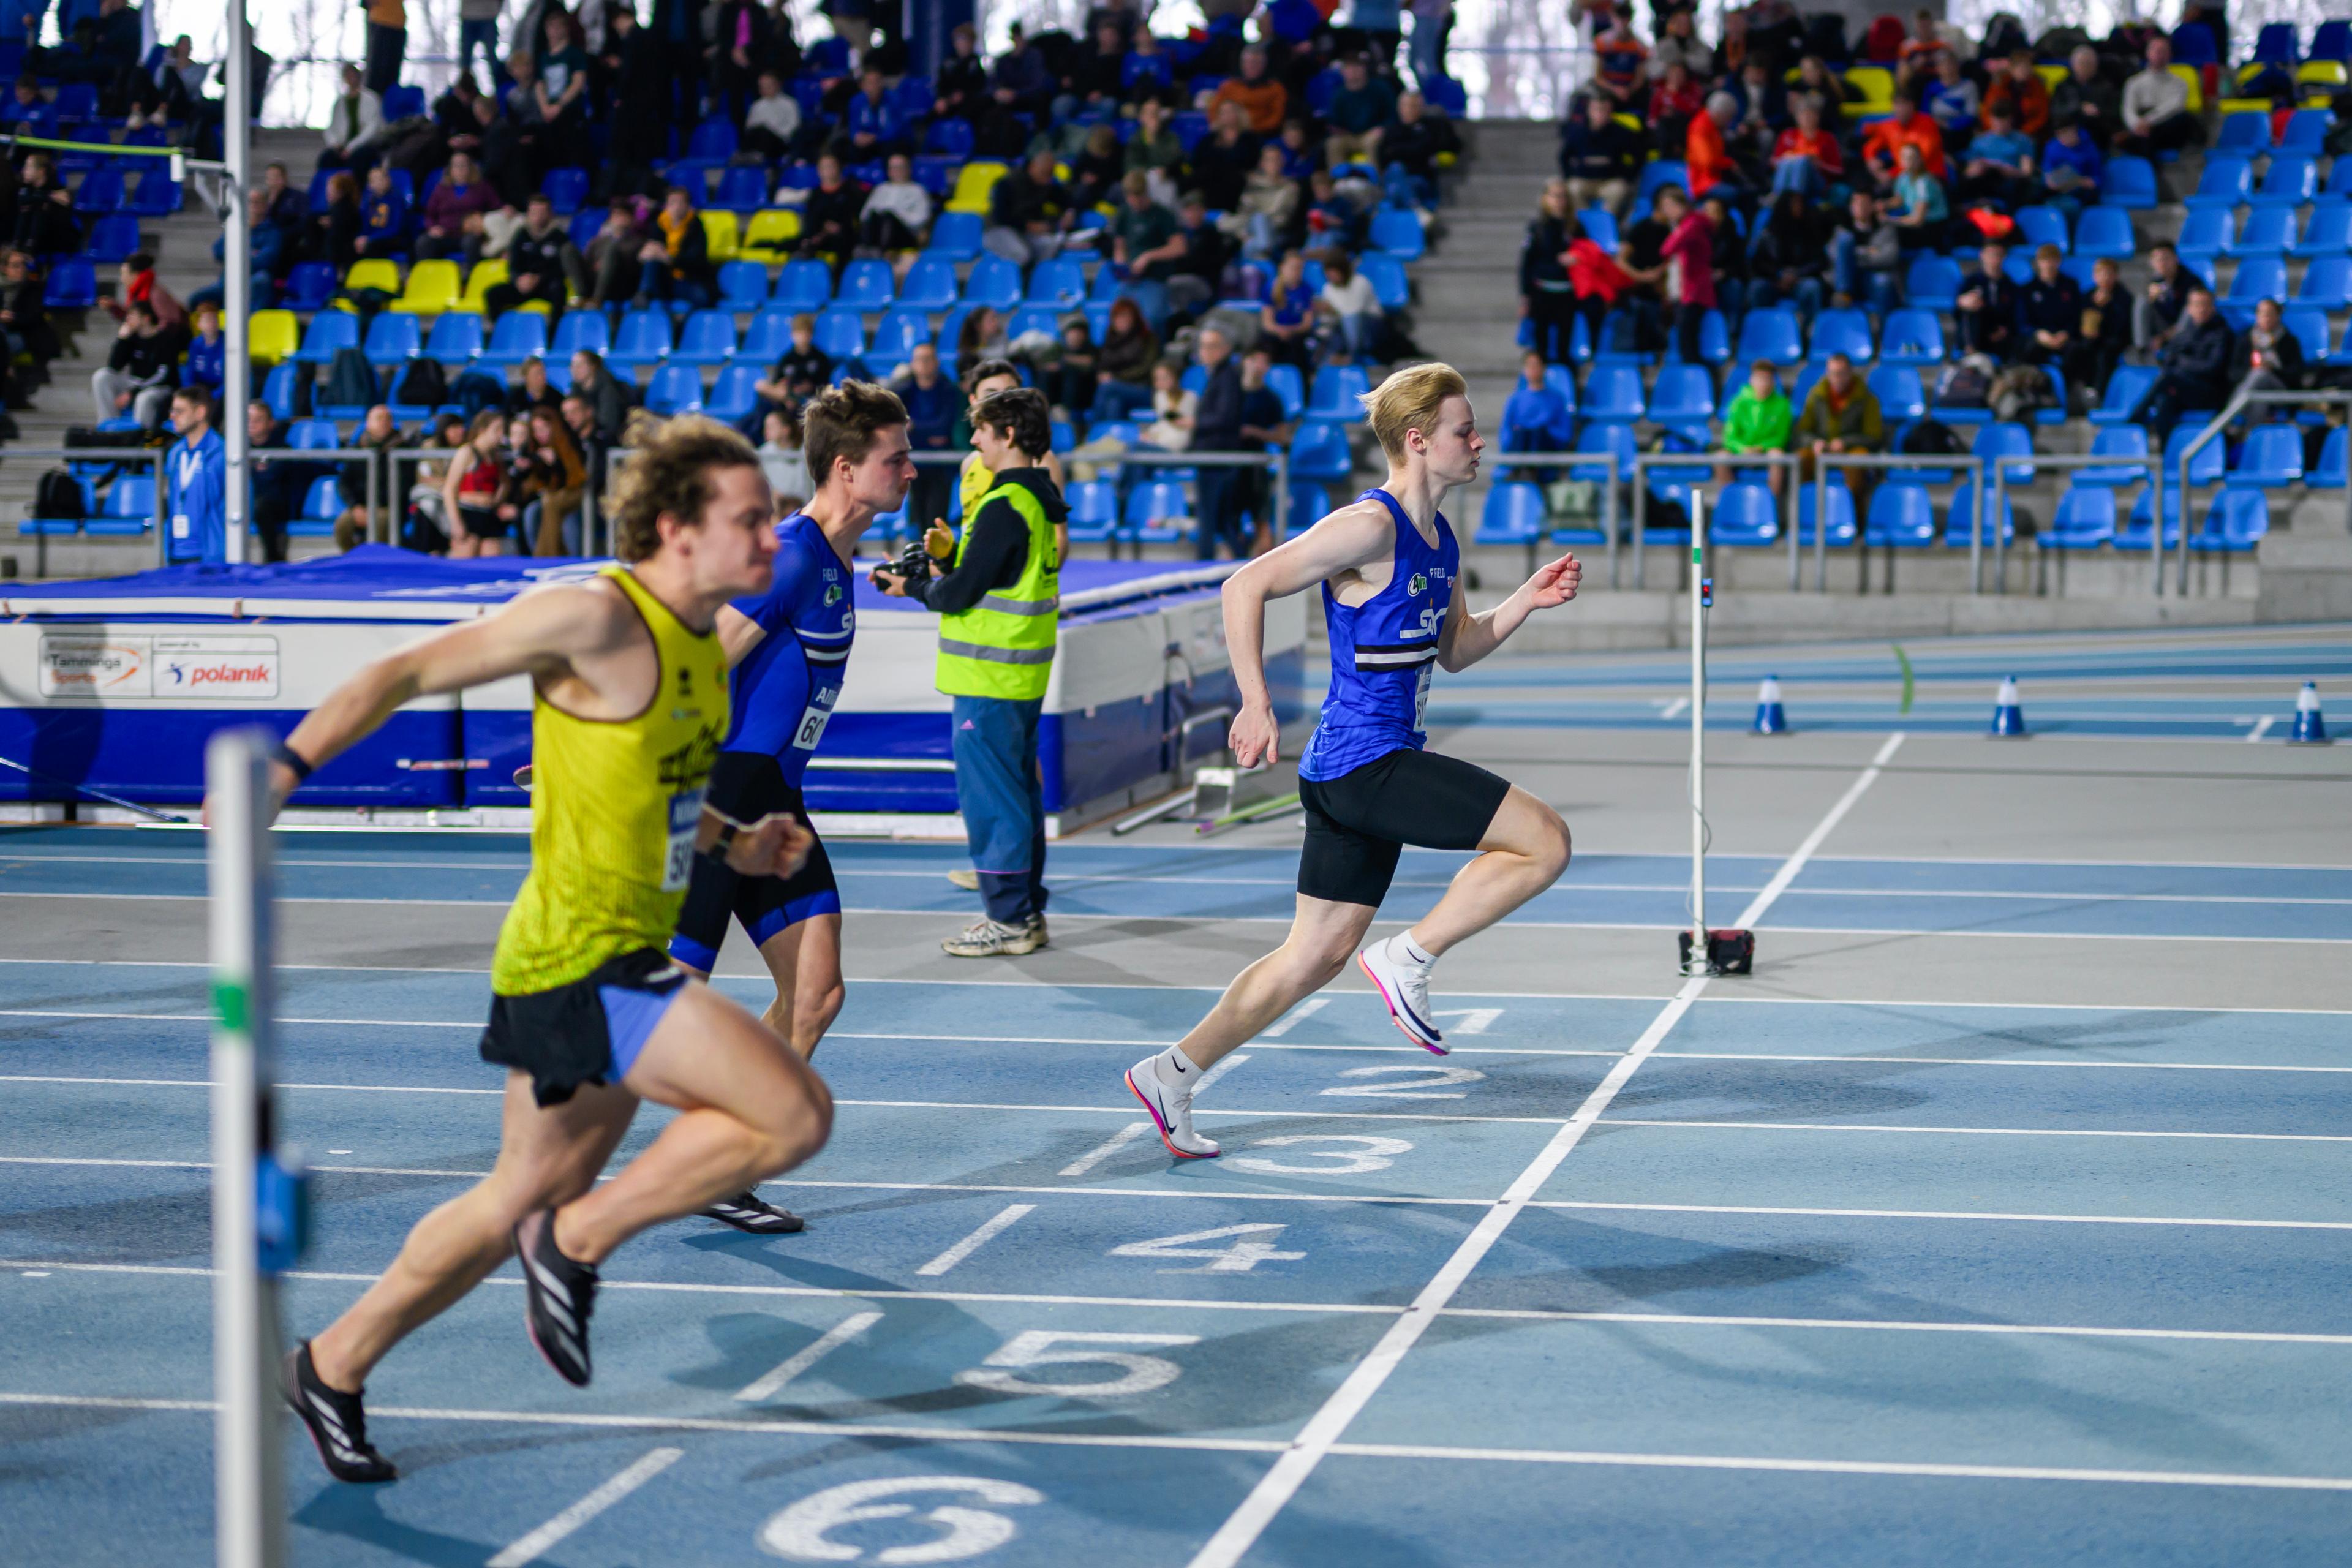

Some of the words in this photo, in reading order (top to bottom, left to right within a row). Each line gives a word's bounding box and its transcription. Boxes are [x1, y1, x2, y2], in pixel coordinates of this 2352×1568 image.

[50, 654, 121, 671] Tamminga
[190, 662, 271, 687] polanik
[1320, 1065, 1487, 1099] 2
[1233, 1135, 1414, 1174] 3
[1110, 1223, 1307, 1272] 4
[954, 1330, 1201, 1396] 5
[760, 1476, 1046, 1564] 6
